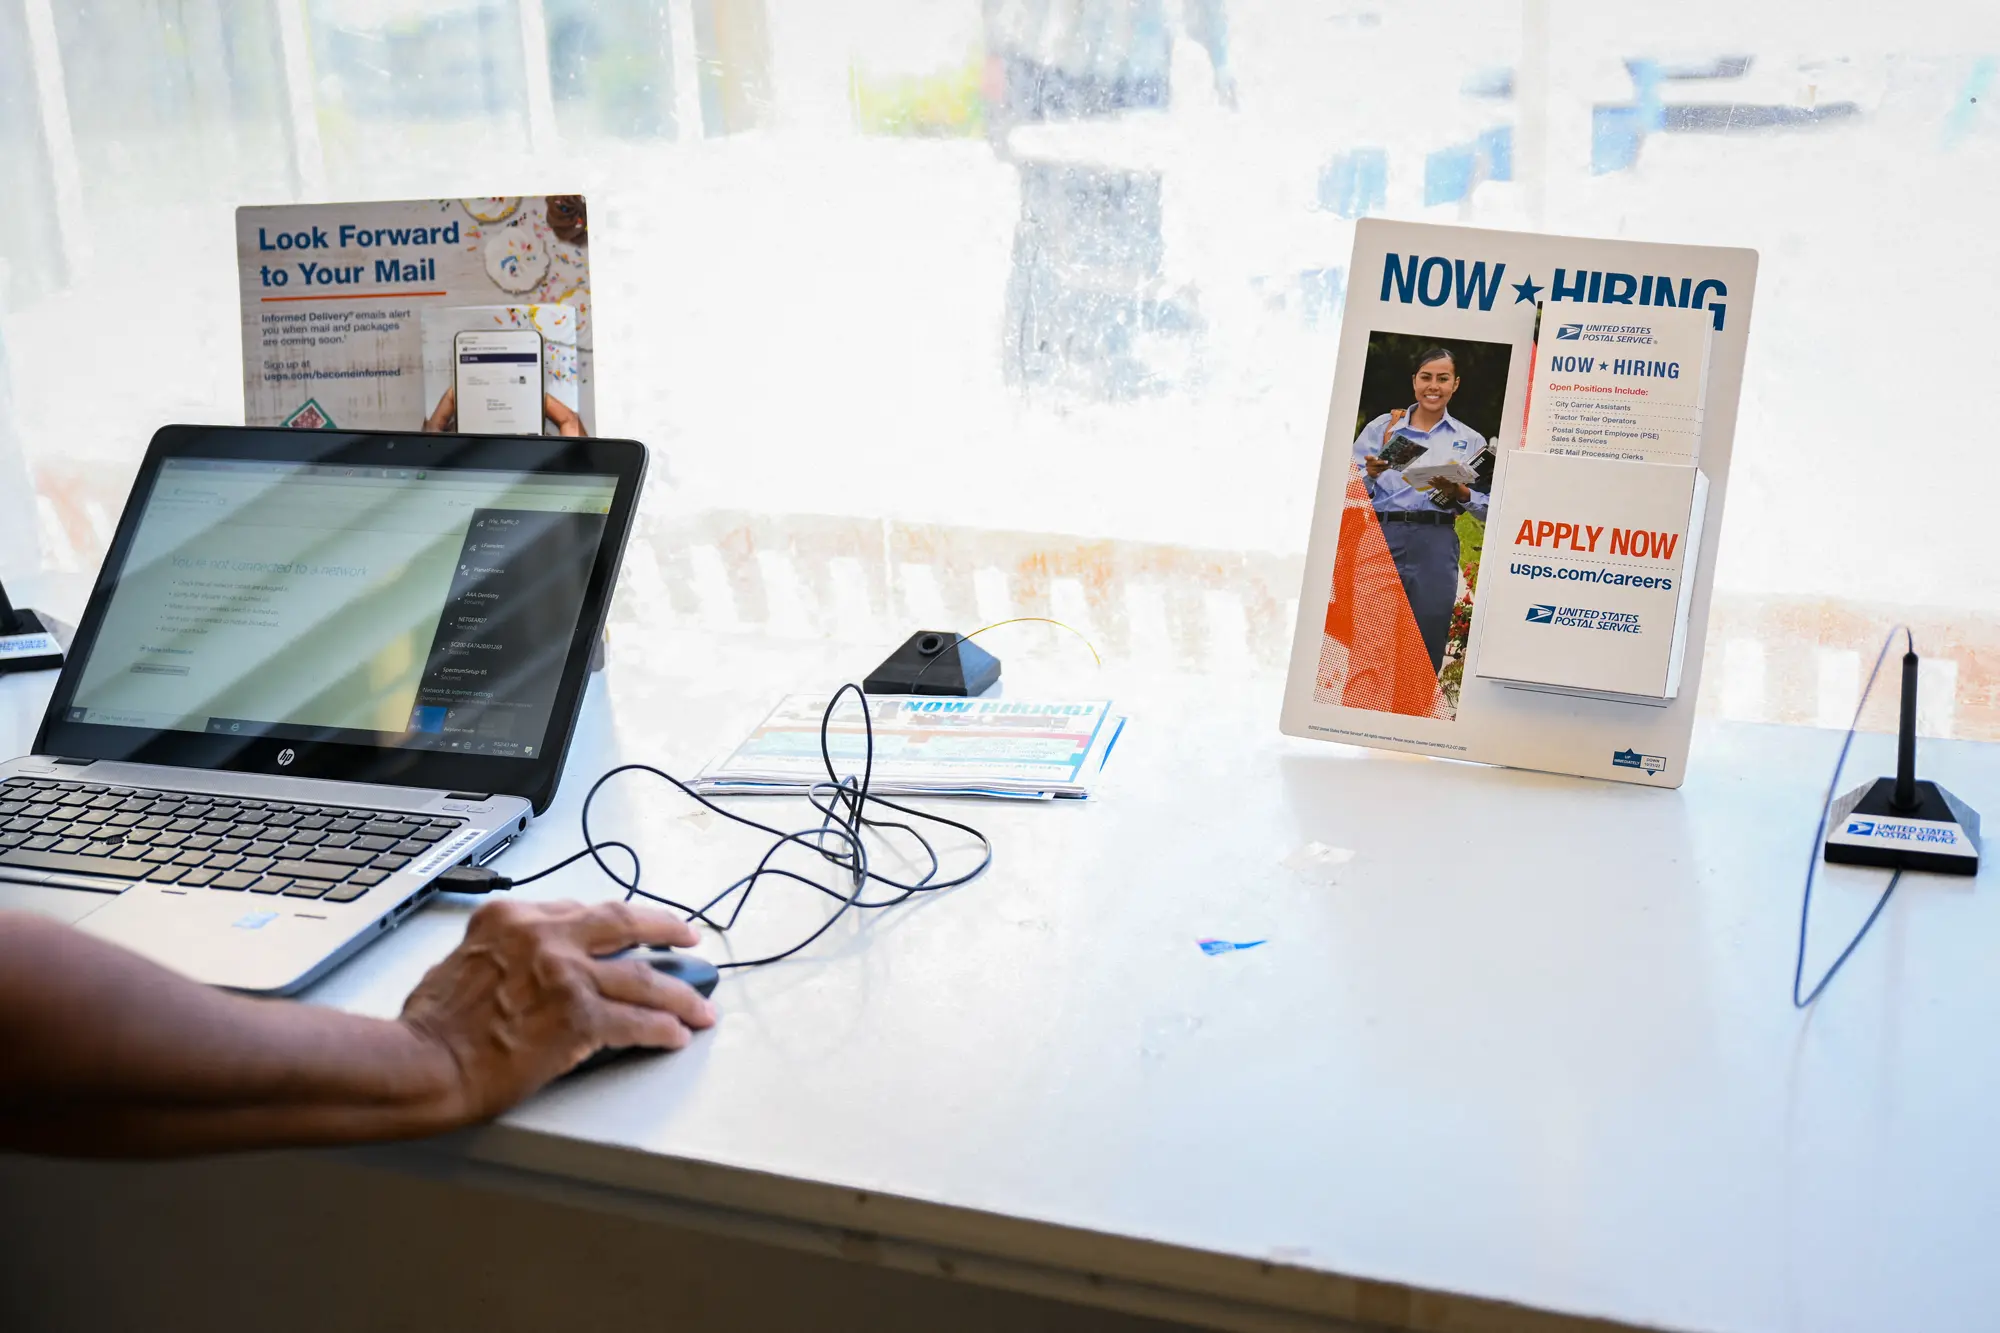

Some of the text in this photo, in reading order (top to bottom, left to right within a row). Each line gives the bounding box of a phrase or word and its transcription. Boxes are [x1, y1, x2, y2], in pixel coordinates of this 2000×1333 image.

[259, 221, 460, 251] Look Forward
[260, 258, 436, 287] to Your Mail
[1380, 252, 1728, 331] NOW HIRING
[261, 312, 306, 323] Informed
[355, 310, 385, 320] emails
[388, 309, 411, 319] alert
[261, 322, 400, 336] you when mail and packages
[1586, 324, 1651, 335] UNITED STATES
[262, 338, 277, 346] are
[279, 336, 315, 348] coming
[1583, 333, 1653, 345] POSTAL SERVICE
[264, 360, 310, 372] Sign up at
[1551, 356, 1680, 379] NOW HIRING
[264, 368, 401, 381] usps.com/becomeinformed
[1549, 383, 1649, 396] Open Positions Include:
[1555, 401, 1631, 411] City Carrier Assistants
[1554, 413, 1637, 425] Tractor Trailer Operators
[1551, 435, 1570, 443] Sales
[1578, 437, 1608, 445] Services
[1575, 428, 1603, 437] Support
[1604, 430, 1639, 439] Employee
[1640, 431, 1660, 440] (PSE)
[1581, 450, 1620, 460] Processing
[1621, 453, 1644, 461] Clerks
[1514, 519, 1679, 560] APPLY NOW
[210, 559, 229, 570] not
[231, 560, 293, 575] connected
[294, 562, 308, 574] to
[309, 567, 317, 575] a
[320, 565, 368, 577] network
[1510, 562, 1673, 591] usps.com/careers
[1558, 606, 1640, 623] UNITED STATES
[1554, 616, 1641, 635] POSTAL SERVICE
[903, 701, 974, 713] NOW
[1876, 823, 1955, 837] UNITED STATES
[1874, 830, 1957, 845] POSTAL SERVICE
